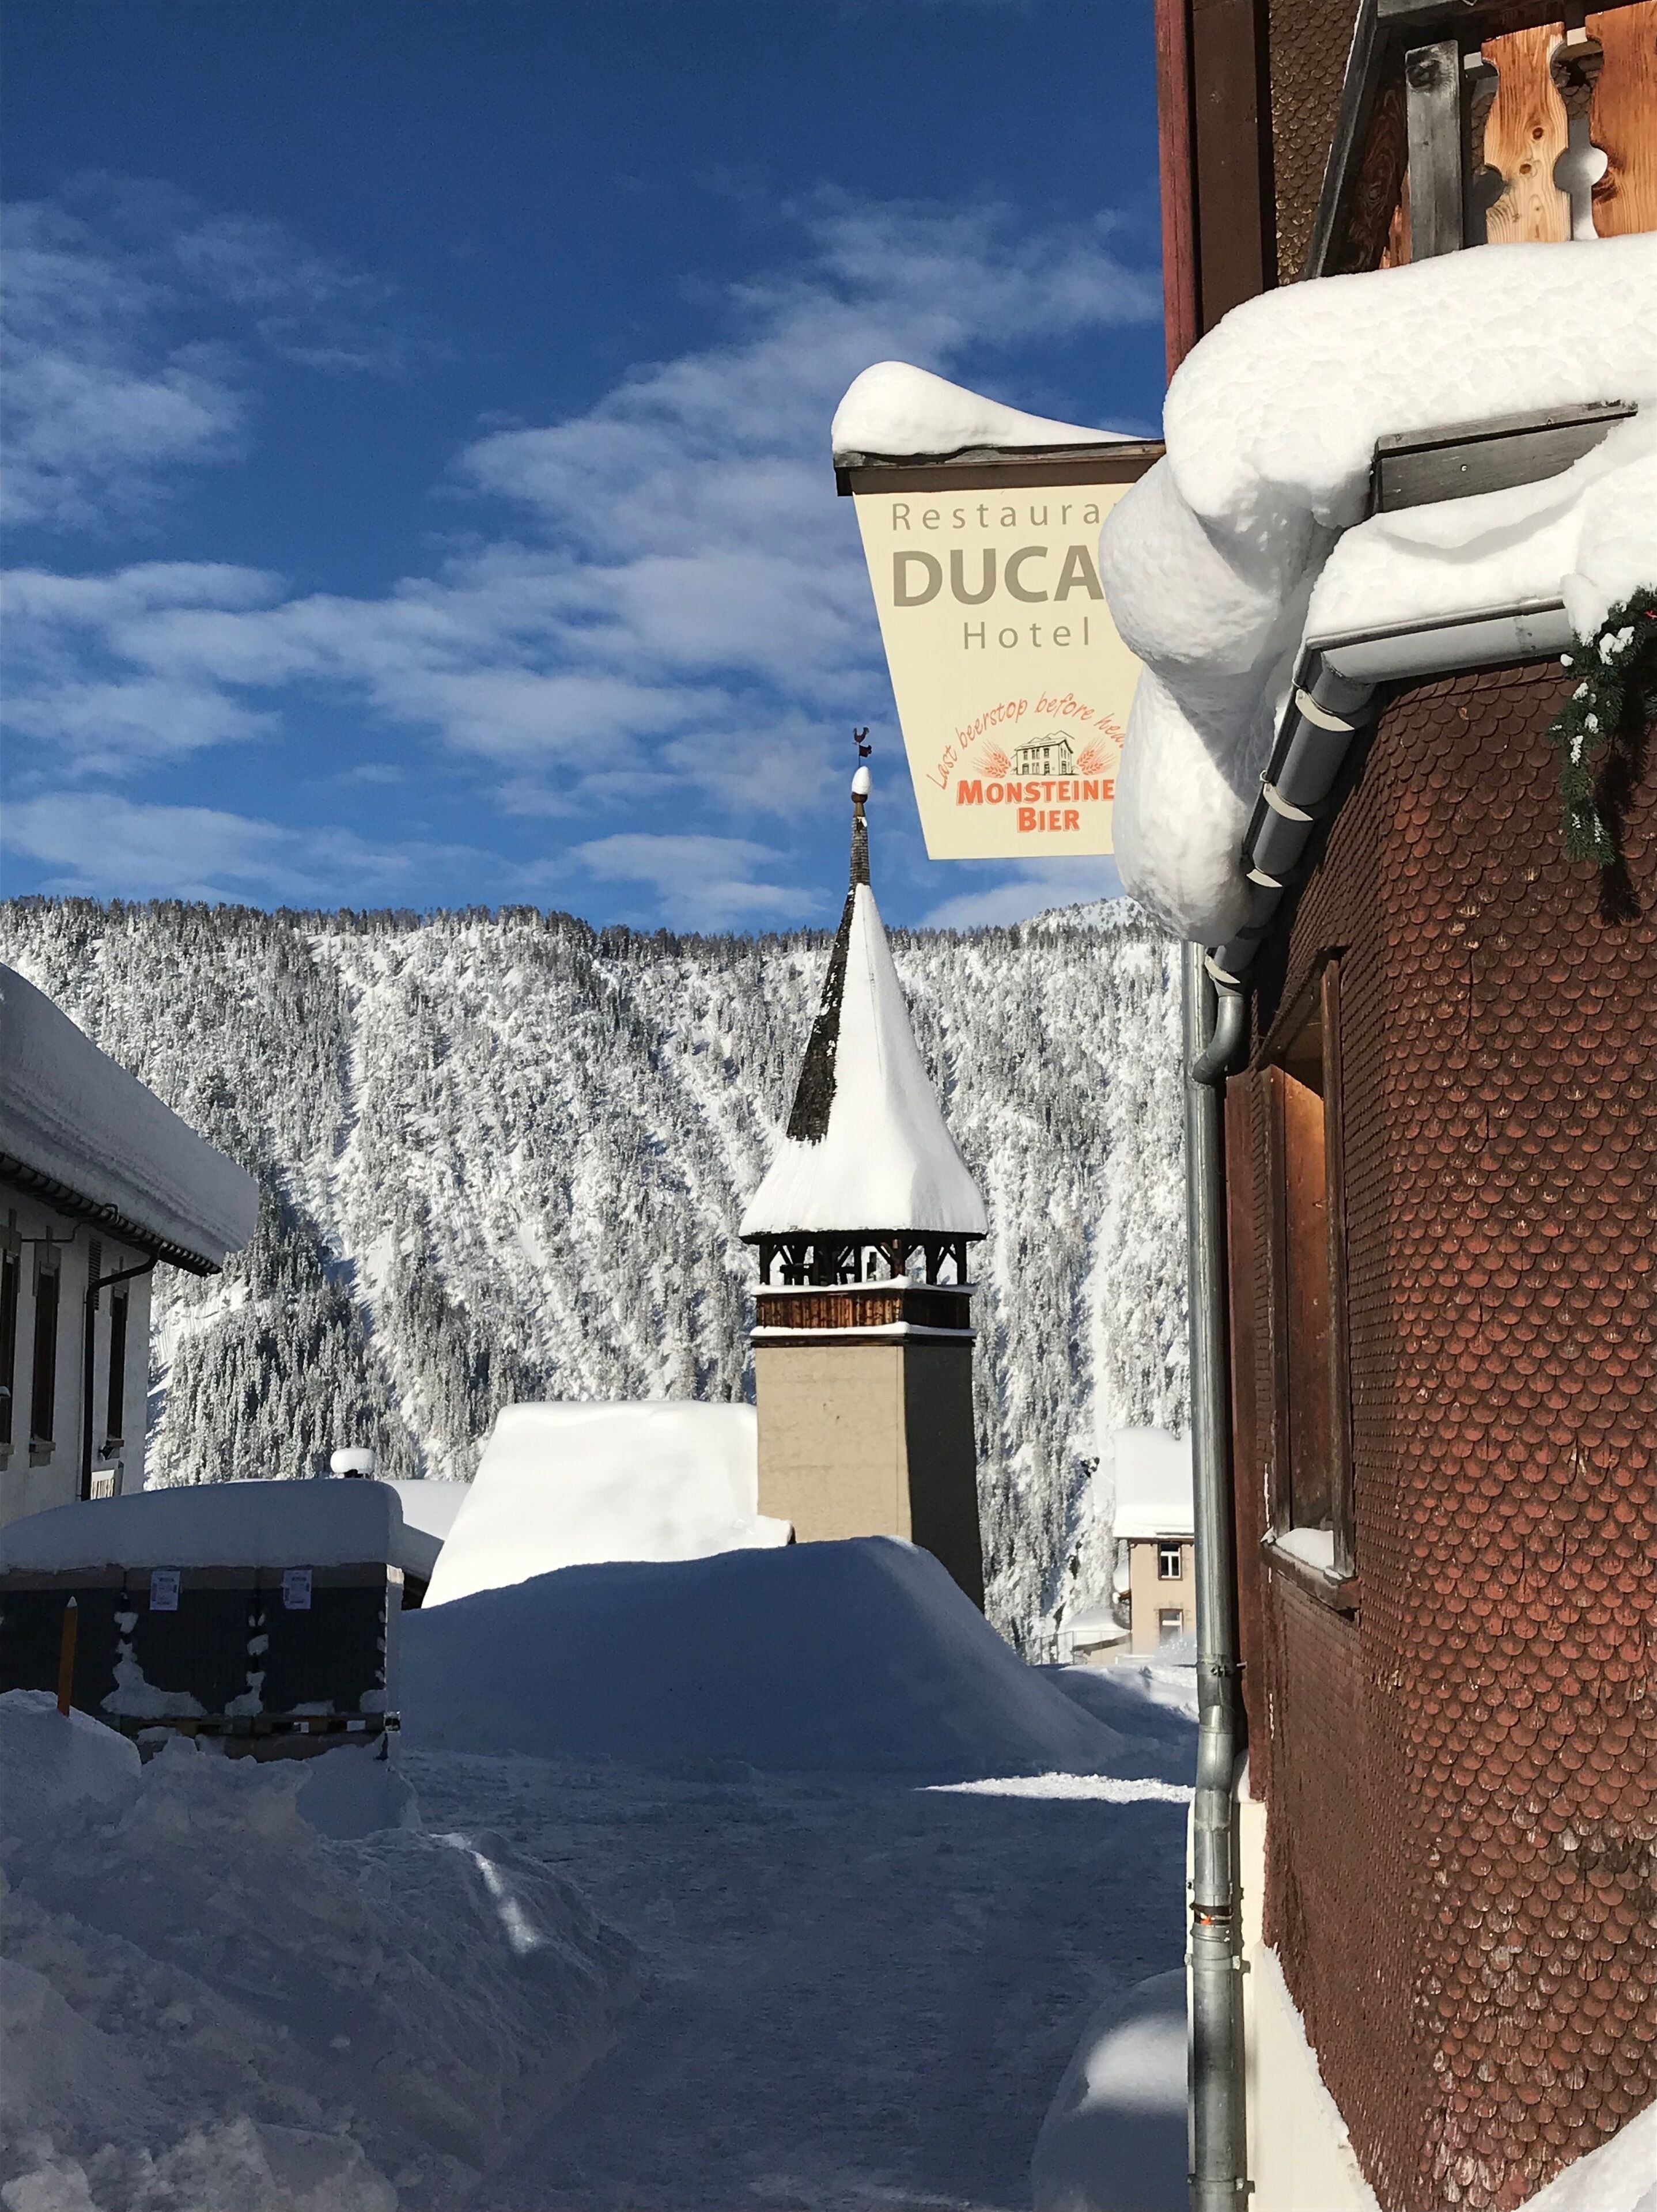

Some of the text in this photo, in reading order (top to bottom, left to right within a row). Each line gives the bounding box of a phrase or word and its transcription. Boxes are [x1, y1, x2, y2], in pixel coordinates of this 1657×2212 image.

[892, 501, 1117, 530] Restaura
[892, 544, 1104, 607] DUCA
[964, 616, 1089, 649] Hotel
[926, 691, 1126, 790] Last beerstop before hea
[956, 779, 1115, 806] MONSTEINE
[1016, 806, 1081, 833] BIER
